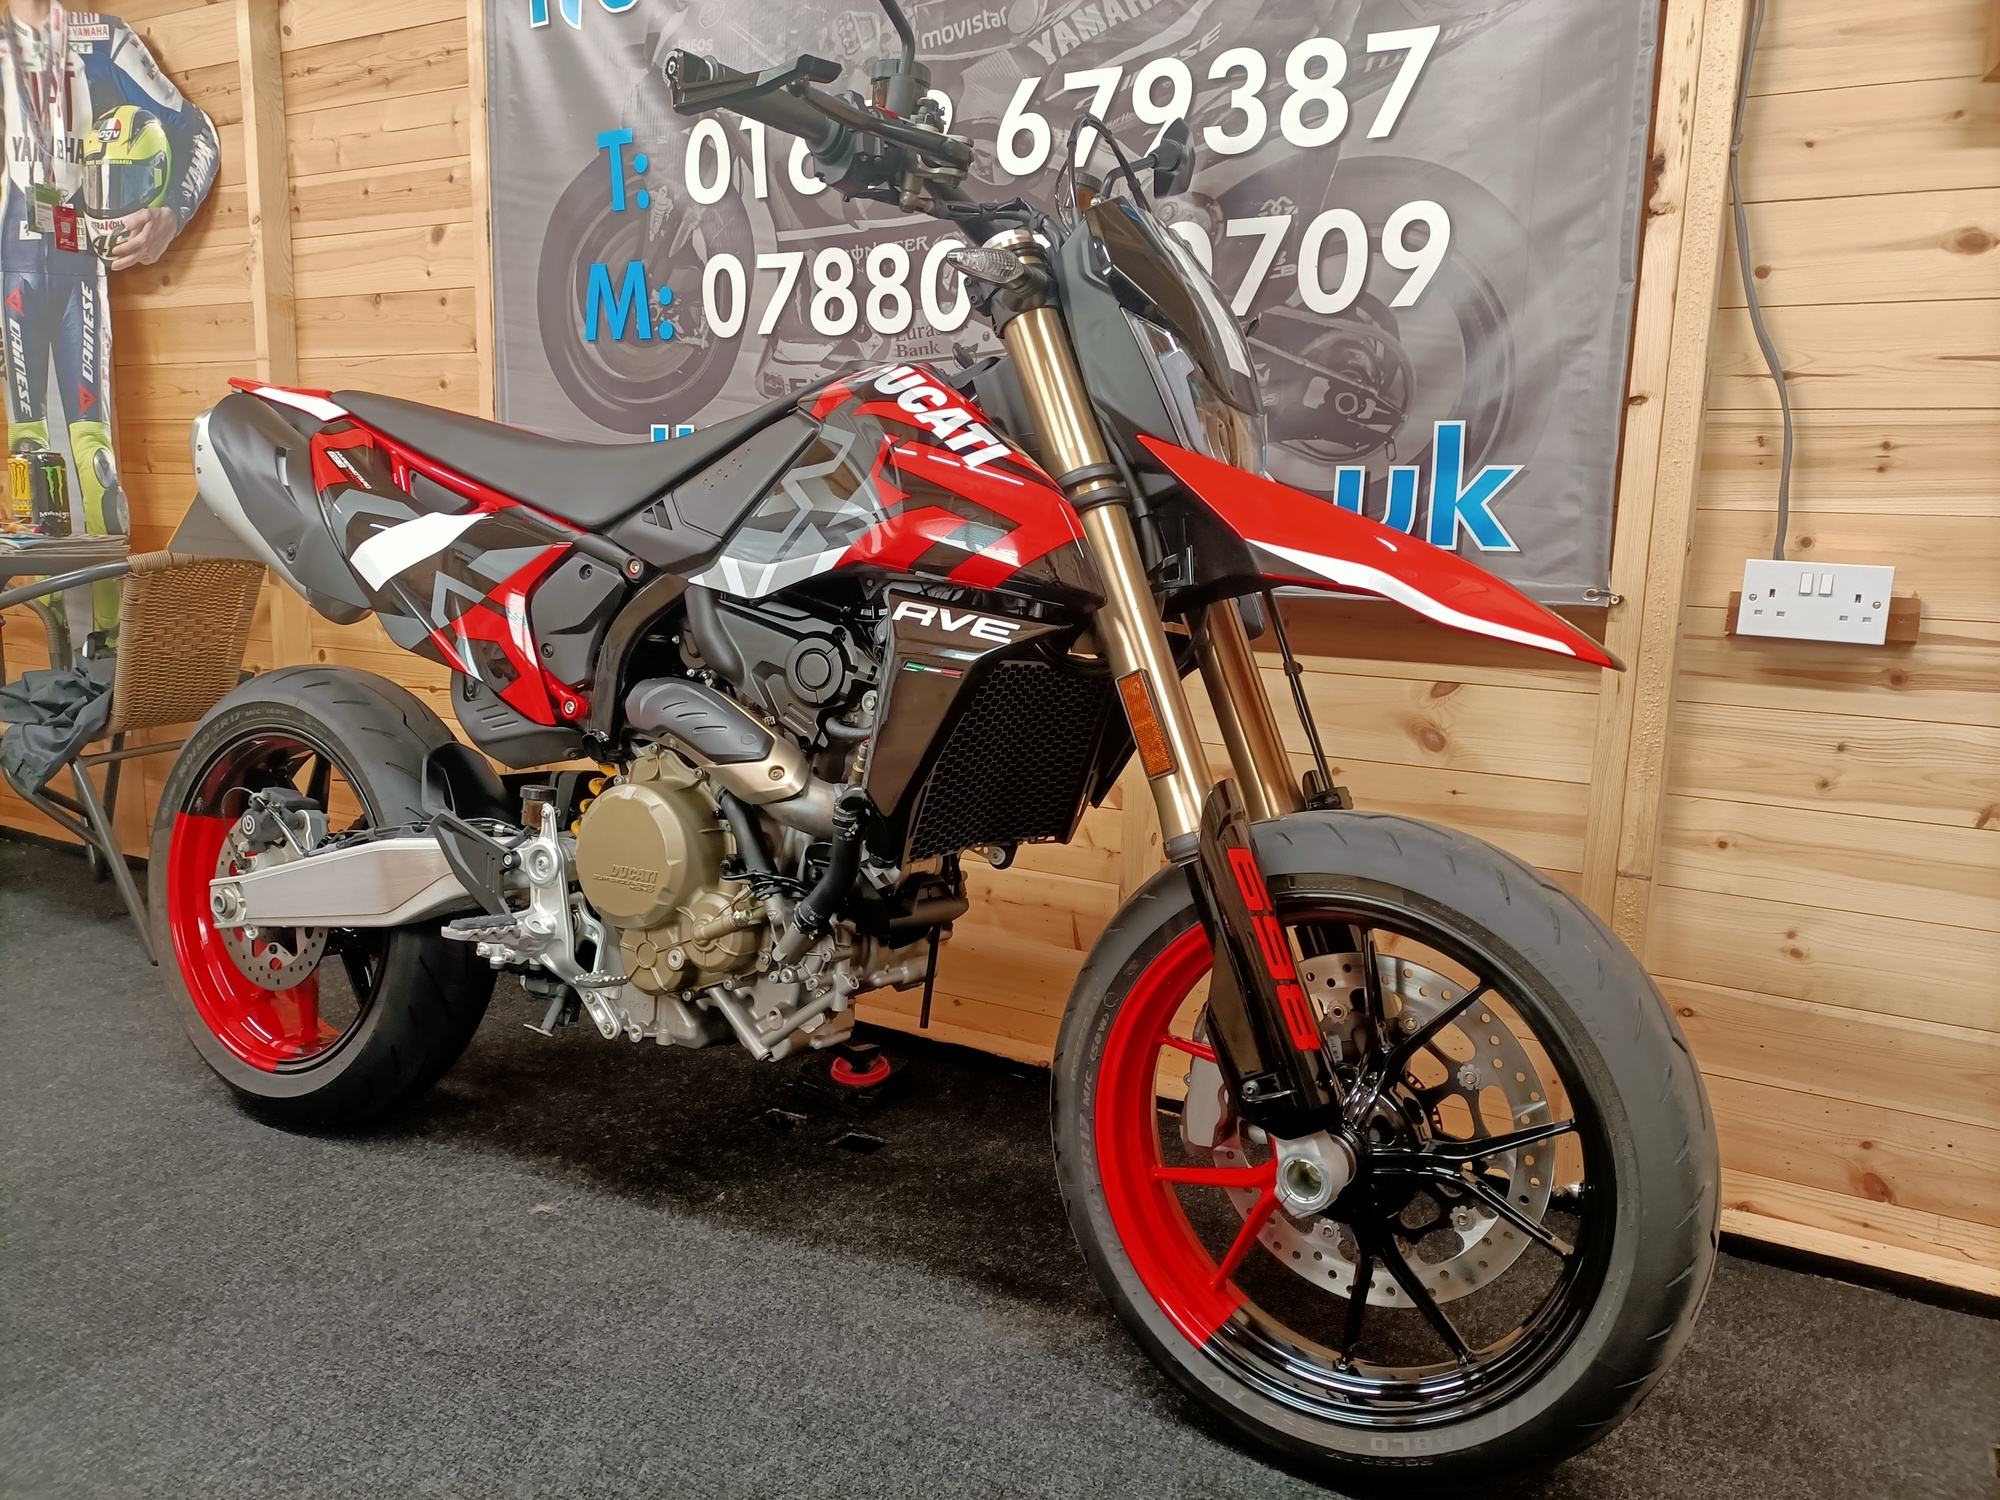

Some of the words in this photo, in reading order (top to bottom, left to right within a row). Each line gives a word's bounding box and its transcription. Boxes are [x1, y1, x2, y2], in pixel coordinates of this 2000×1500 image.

[72, 26, 109, 37] YAMAHA
[921, 6, 1007, 50] movistar
[1027, 0, 1160, 65] YAMA
[596, 127, 649, 212] T:
[996, 25, 1441, 176] 679387
[12, 136, 85, 166] YAHA
[585, 260, 674, 342] M:
[702, 239, 972, 338] 07880
[896, 340, 941, 358] Bank
[892, 601, 1021, 645] RVE
[610, 863, 659, 884] DUCATI
[1227, 847, 1322, 1050] 698
